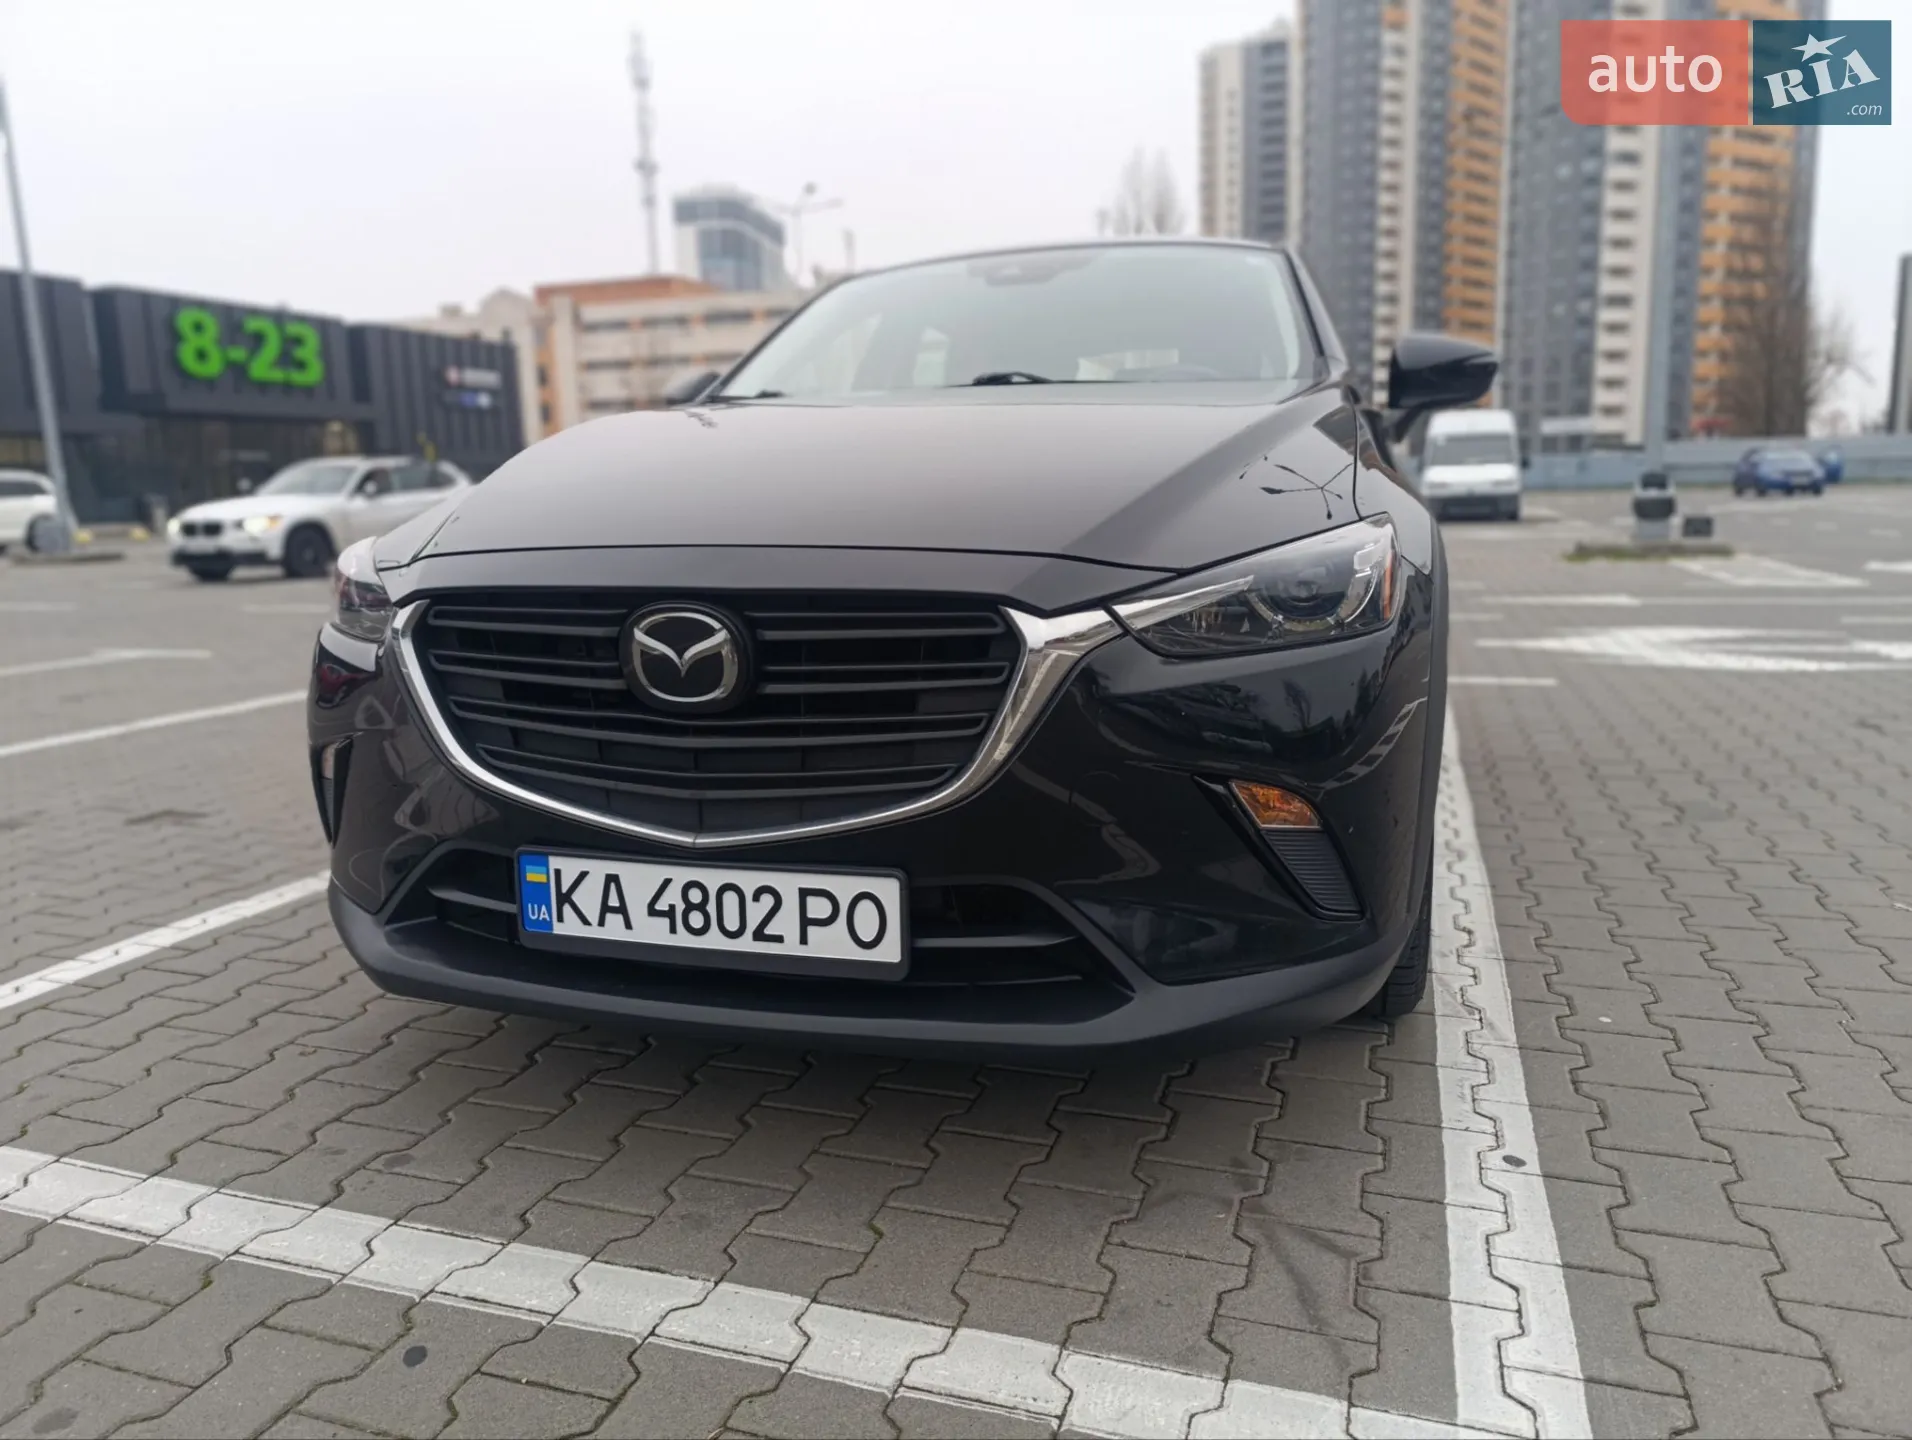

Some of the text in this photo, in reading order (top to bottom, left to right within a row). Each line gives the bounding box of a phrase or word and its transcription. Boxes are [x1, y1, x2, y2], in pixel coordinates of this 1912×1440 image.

[175, 307, 325, 387] 8-23
[527, 903, 551, 922] UA
[553, 867, 888, 950] KA 4802 PO
